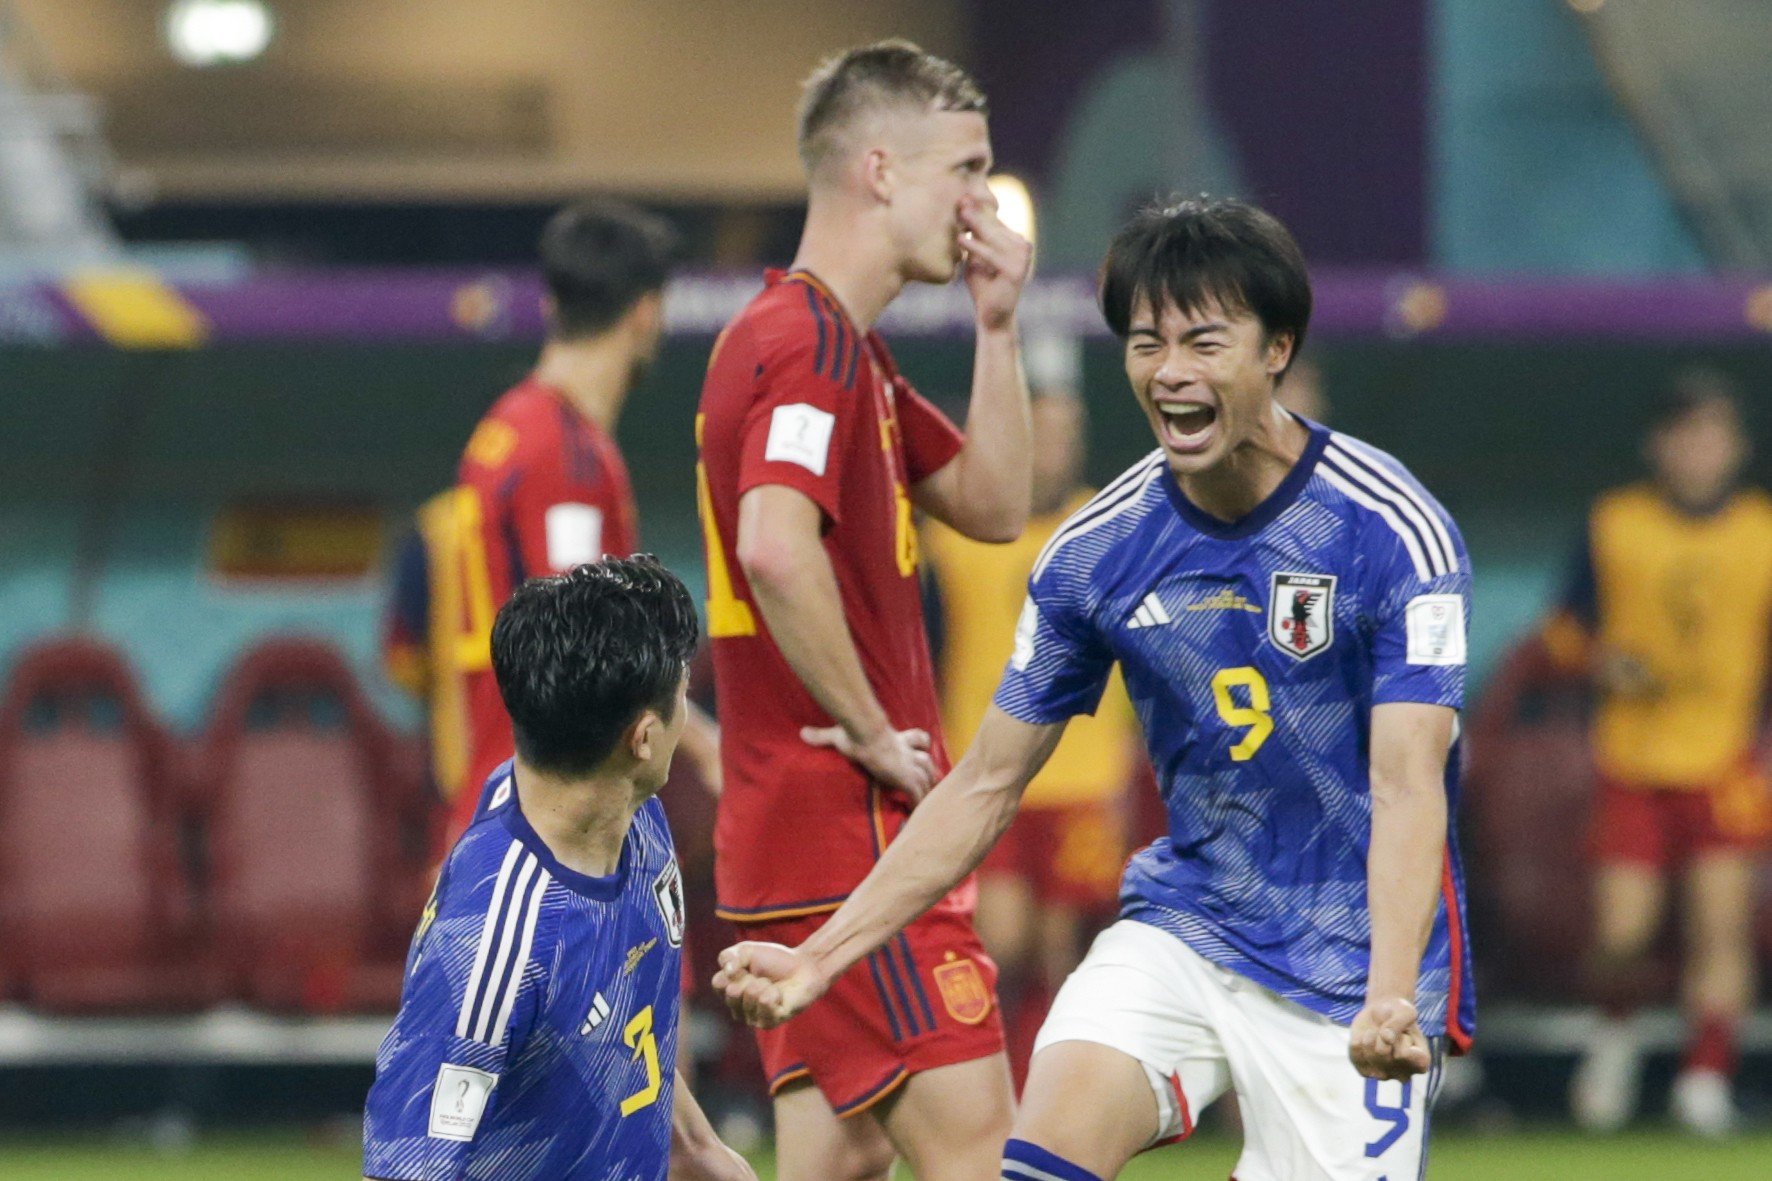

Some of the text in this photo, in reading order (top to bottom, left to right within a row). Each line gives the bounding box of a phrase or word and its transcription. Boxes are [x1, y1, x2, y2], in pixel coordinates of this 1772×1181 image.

[1287, 576, 1321, 586] JAPAN
[1211, 666, 1275, 762] 9
[620, 1005, 661, 1118] 3
[1363, 1076, 1412, 1158] 9
